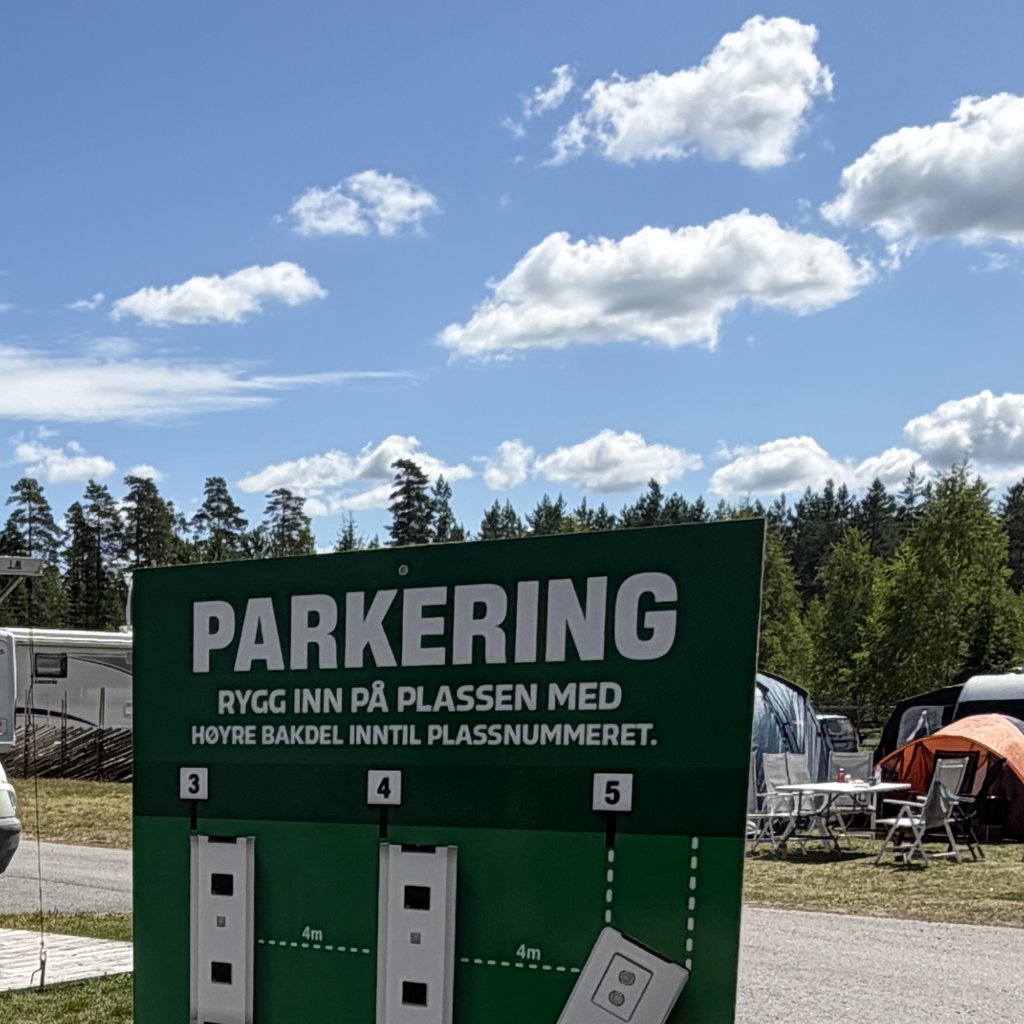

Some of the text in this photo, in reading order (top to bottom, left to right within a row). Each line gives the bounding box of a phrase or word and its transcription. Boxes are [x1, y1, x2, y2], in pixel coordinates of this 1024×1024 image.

[192, 571, 678, 674] PARKERING
[218, 680, 623, 715] RYGG INN PÅ PLASSEN MED
[191, 723, 658, 746] HØYRE BAKDEL INNTIL PLASSNUMMERET.
[187, 774, 200, 794] 3
[377, 777, 391, 800] 4
[604, 780, 621, 804] 5
[301, 926, 323, 942] 4m
[516, 944, 541, 962] 4m
